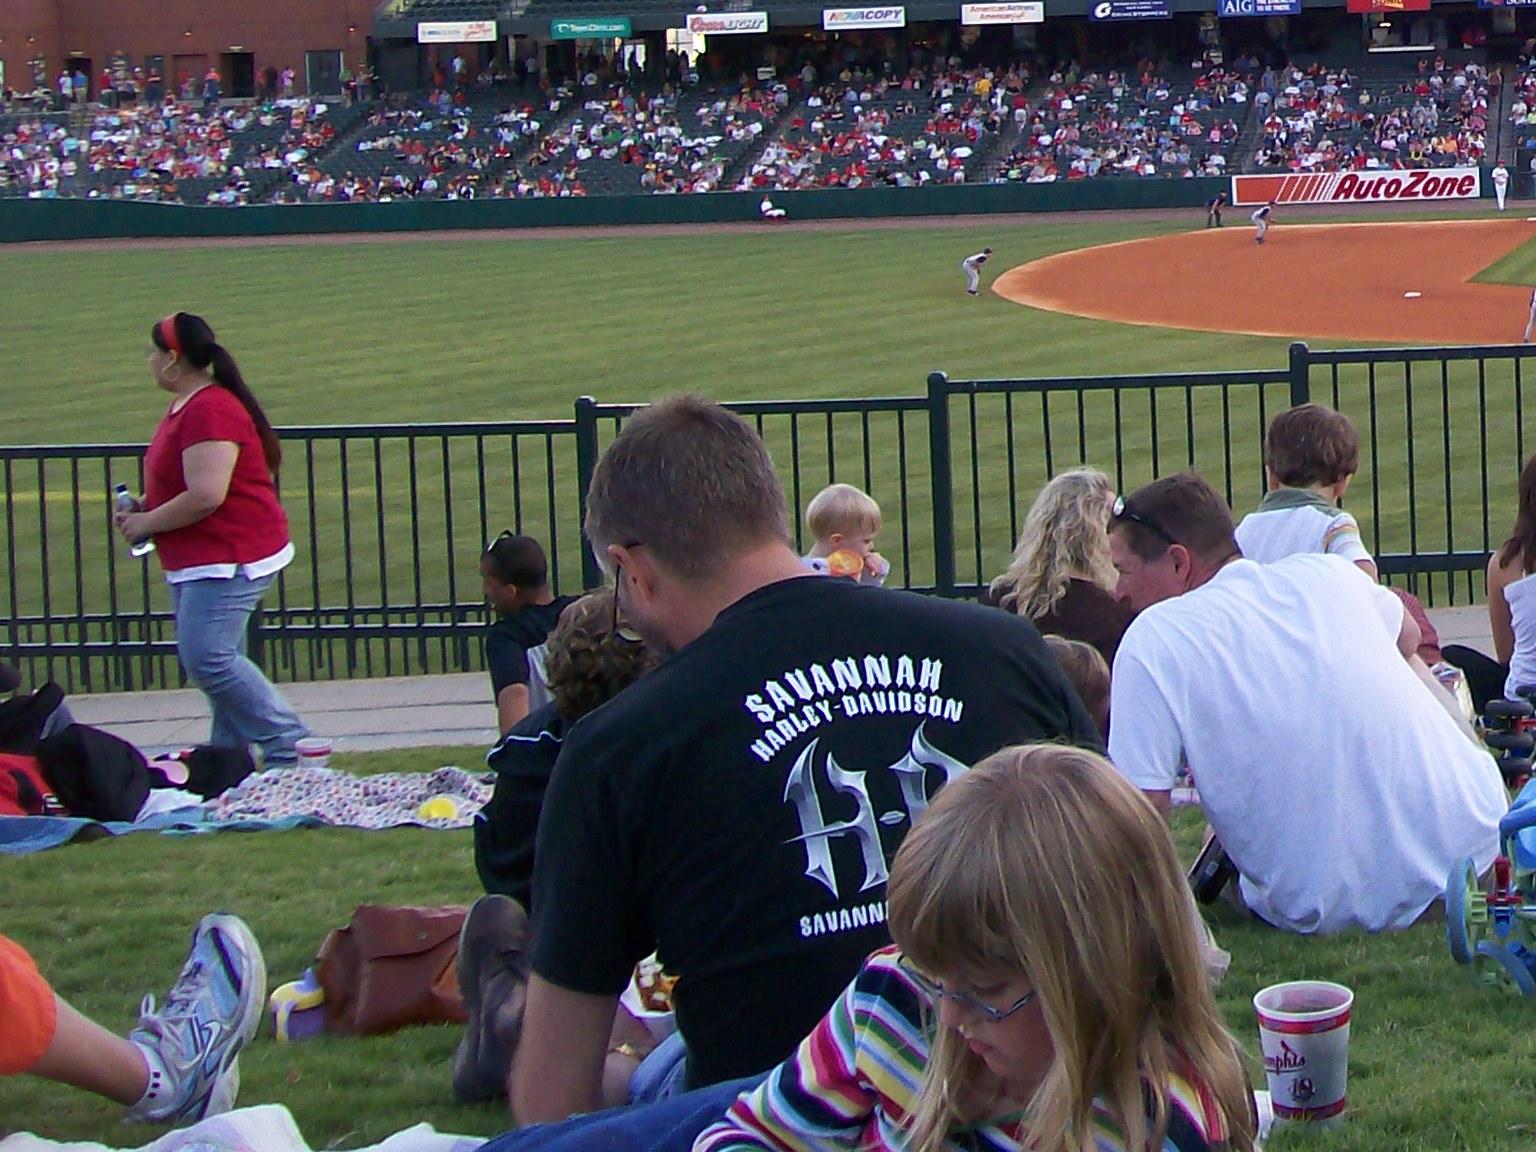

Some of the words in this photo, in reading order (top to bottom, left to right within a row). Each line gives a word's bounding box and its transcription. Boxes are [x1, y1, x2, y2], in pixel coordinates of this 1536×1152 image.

[829, 9, 903, 22] NOVACOPY
[1224, 0, 1252, 13] AIG
[725, 18, 765, 31] LIGHT
[1331, 171, 1476, 199] AutoZone
[745, 654, 944, 724] SAVANNAH
[751, 691, 964, 763] HARLEY-DAVIDSON
[800, 899, 889, 938] SAVANN
